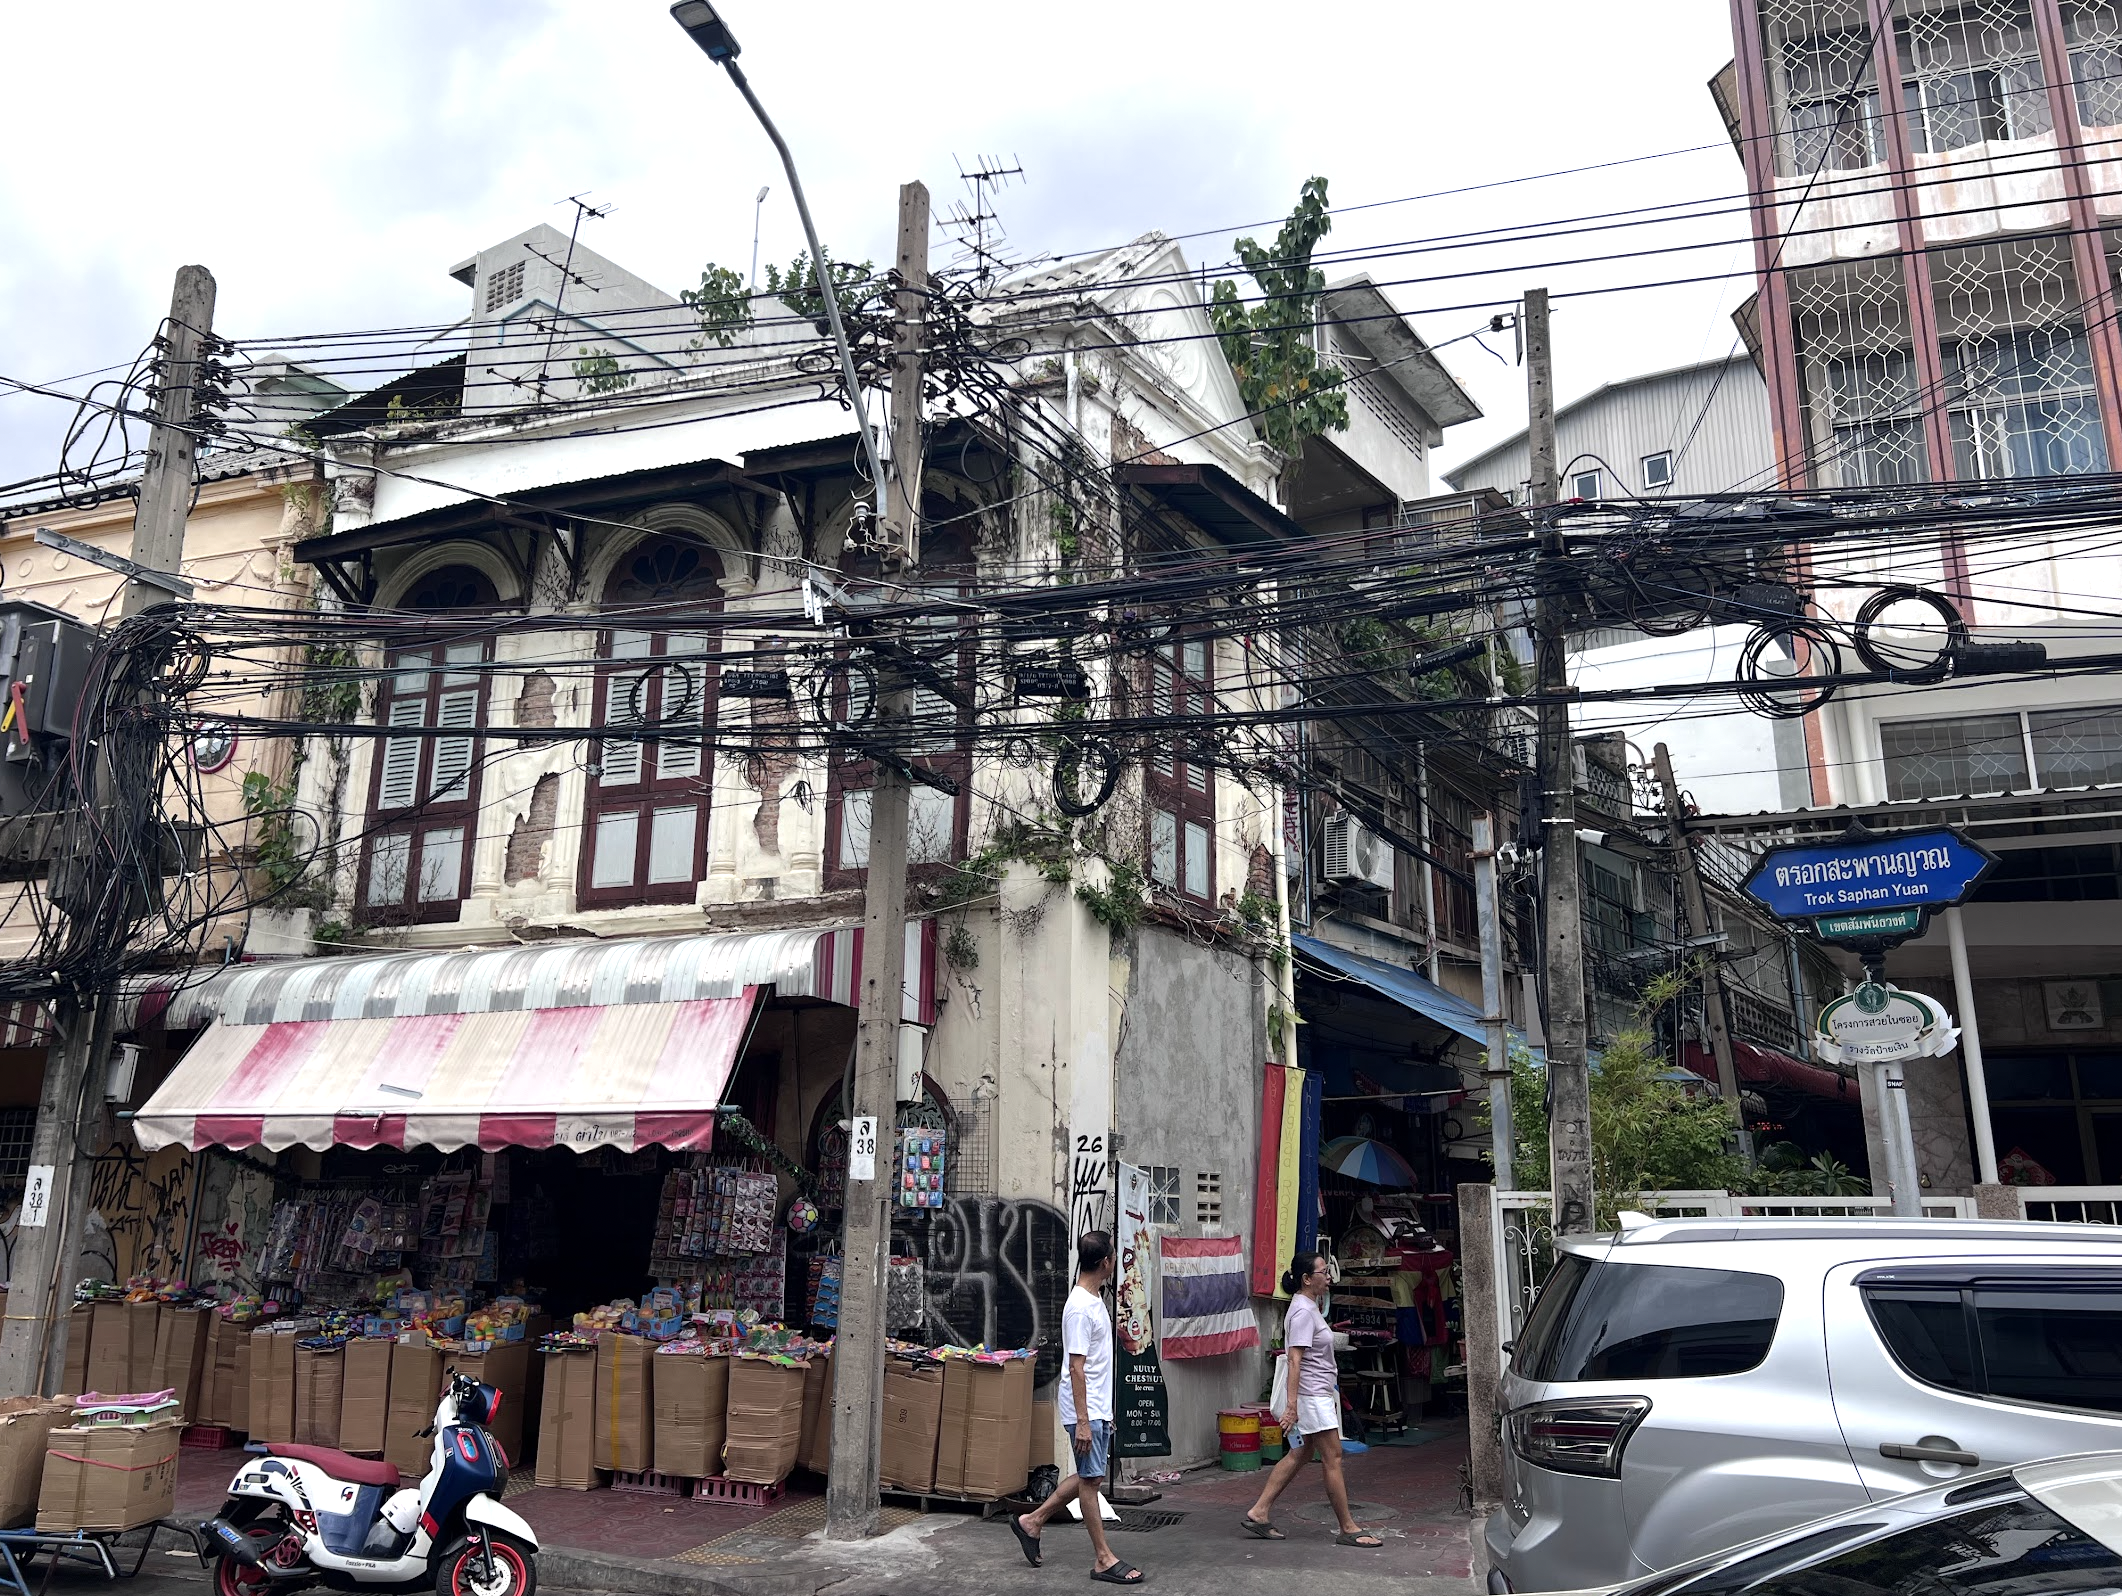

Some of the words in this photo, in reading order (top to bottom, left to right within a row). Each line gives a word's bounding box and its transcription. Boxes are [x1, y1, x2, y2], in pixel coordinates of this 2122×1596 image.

[1804, 891, 1835, 906] Trok
[1837, 887, 1889, 905] Saphan
[1892, 883, 1929, 898] Yuan
[1829, 911, 1907, 932] เขตสัมพันธวงศ์
[1831, 1014, 1919, 1030] โครงการสวยในซอย
[1849, 1041, 1909, 1055] รางวัลป้ายเงิน
[856, 1138, 875, 1155] 38
[1077, 1134, 1103, 1153] 26
[28, 1192, 44, 1206] 38
[1138, 1399, 1155, 1407] OPEN
